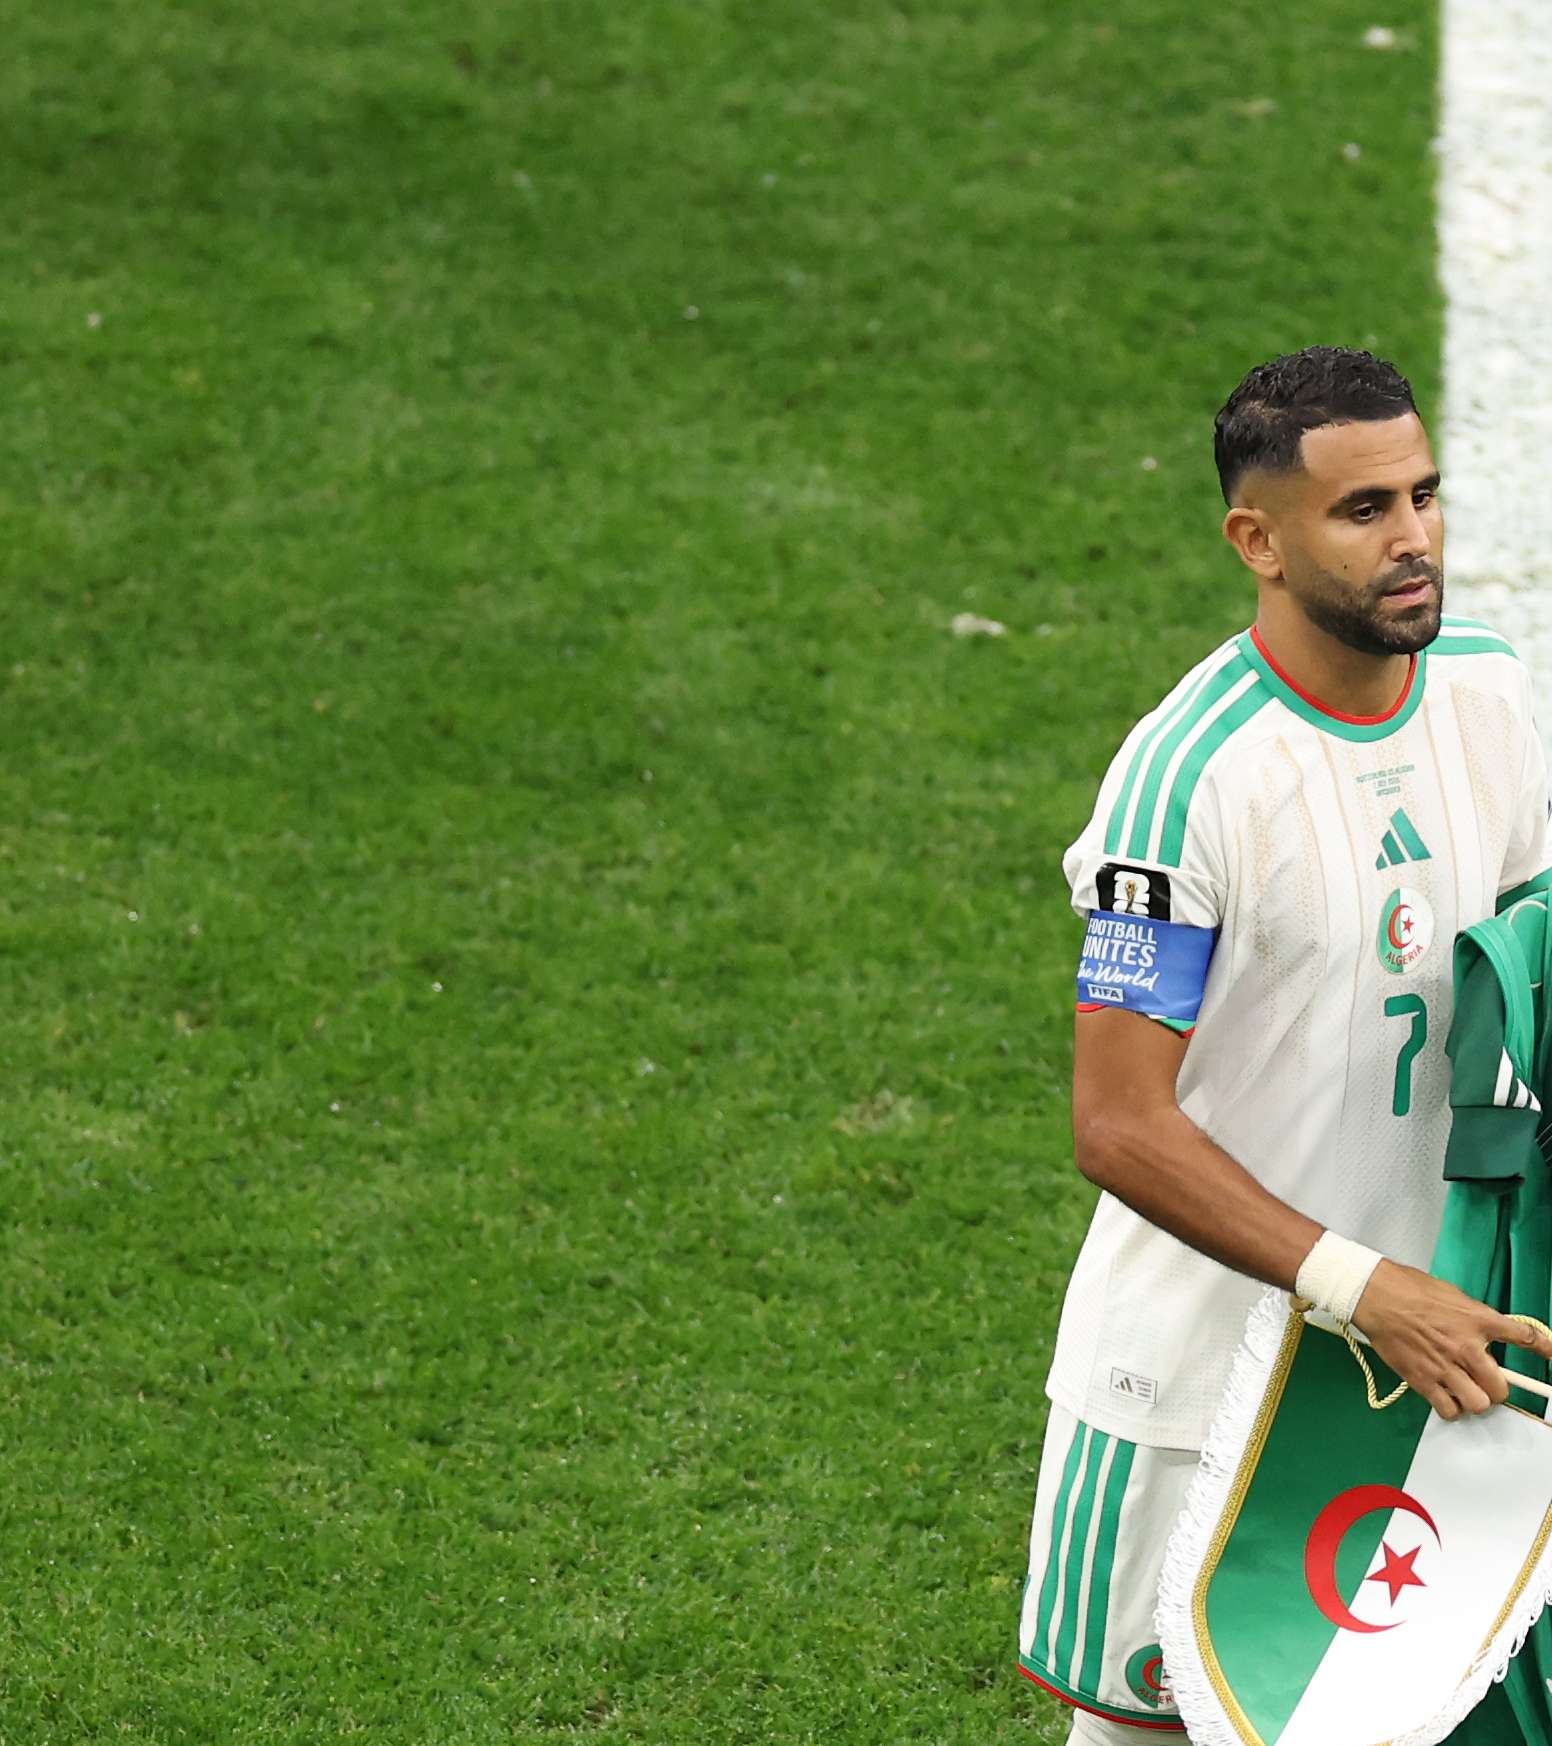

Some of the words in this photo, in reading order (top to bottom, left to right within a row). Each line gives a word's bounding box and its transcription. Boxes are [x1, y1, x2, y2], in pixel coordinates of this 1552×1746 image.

[1088, 918, 1157, 944] FOOTBALL
[1082, 936, 1156, 967] UNITES
[1385, 945, 1424, 966] ALGERIA
[1094, 962, 1159, 991] World
[1091, 986, 1120, 999] FIFA
[1385, 993, 1427, 1116] 7
